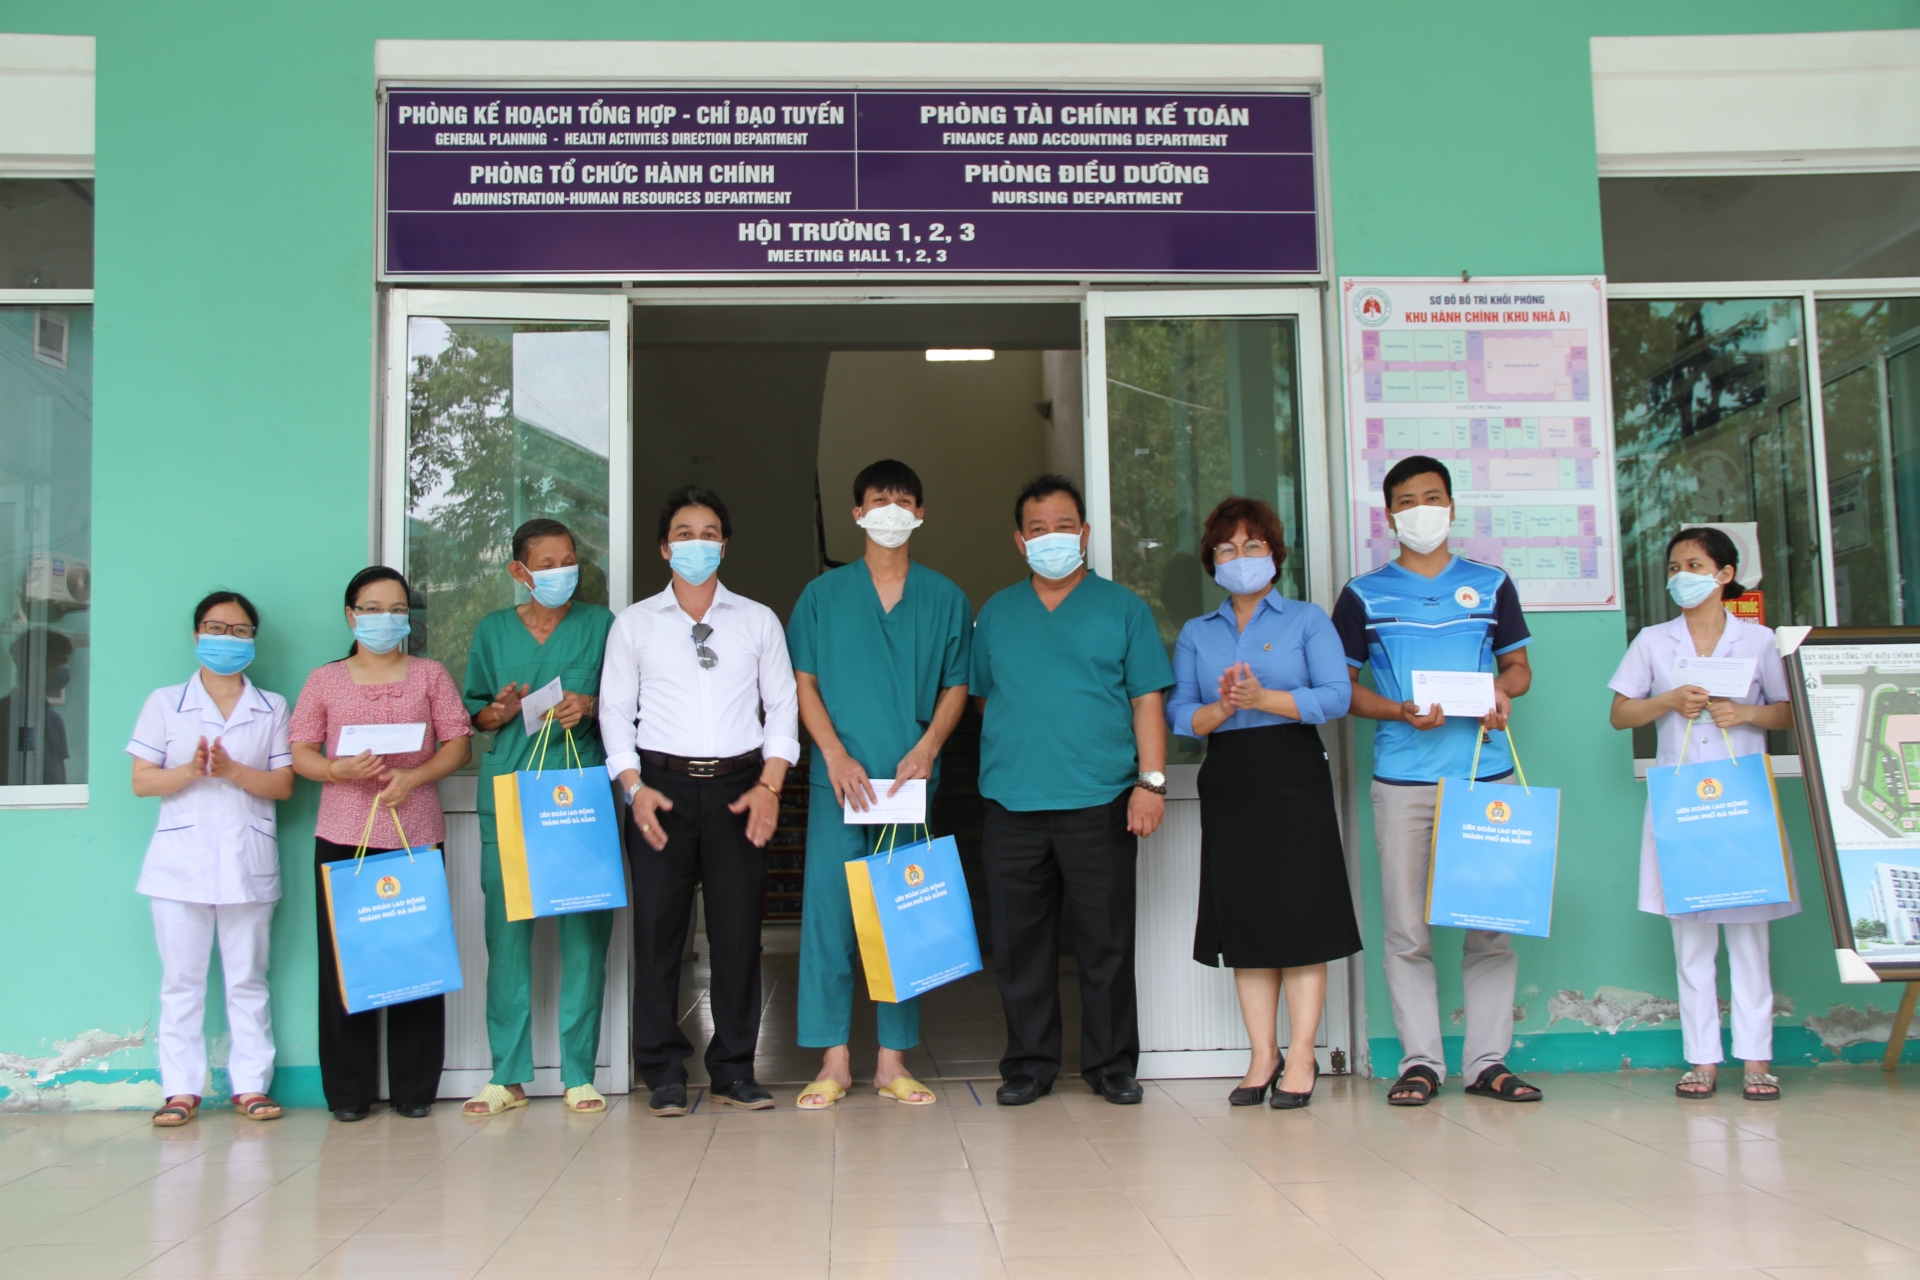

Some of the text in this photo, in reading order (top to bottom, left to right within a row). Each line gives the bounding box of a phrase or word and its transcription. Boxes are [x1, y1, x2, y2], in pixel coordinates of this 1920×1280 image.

[399, 102, 467, 124] PHÒNG
[474, 101, 500, 124] KẾ
[506, 106, 572, 128] HOẠCH
[578, 99, 630, 124] TỔNG
[637, 105, 676, 128] HỢP
[697, 100, 730, 124] CHỈ
[736, 106, 775, 128] ĐẠO
[782, 101, 844, 124] TUYẾN
[921, 102, 1249, 125] PHÒNG TÀI CHÍNH KẾ TOÁN
[436, 133, 486, 145] GENERAL
[490, 133, 547, 145] PLANNING
[565, 133, 605, 145] HEALTH
[609, 133, 668, 145] ACTIVITIES
[672, 133, 731, 145] DIRECTION
[734, 133, 808, 145] DEPARTMENT
[943, 133, 1228, 146] FINANCE AND ACCOUNTING DEPARTMENT
[471, 158, 774, 184] PHÒNG TỔ CHỨC HÀNH CHÍNH
[965, 160, 1208, 183] PHÒNG ĐIỀU DƯỠNG
[453, 192, 792, 205] ADMINISTRATION-HUMAN RESOURCES DEPARTMENT
[992, 191, 1183, 204] NURSING DEPARTMENT
[739, 219, 975, 245] HỘI TRƯỜNG 1, 2, 3
[768, 250, 947, 263] MEETING HALL 1, 2, 3
[1429, 293, 1545, 305] SƠ ĐỒ BỐ TRÍ KHỐI PHÒNG
[1405, 309, 1571, 324] KHU HÀNH CHÍNH (KHU NHÀ A)
[1738, 597, 1759, 613] THUỐC
[578, 808, 595, 816] ĐỘNG
[1676, 806, 1690, 814] LIÊN
[1691, 804, 1711, 813] ĐOÀN
[1726, 800, 1748, 808] ĐỘNG
[541, 818, 560, 826] THÀNH
[581, 815, 596, 823] NẴNG
[1677, 814, 1700, 822] THÀNH
[1728, 808, 1749, 817] NẴNG
[1462, 823, 1476, 831] LIÊN
[1477, 825, 1496, 833] ĐOÀN
[1511, 828, 1532, 837] ĐỘNG
[1462, 831, 1532, 845] THÀNH PHỐ ĐÀ NẴNG
[894, 881, 946, 903] LIÊN ĐOÀN LAO ĐỘNG
[358, 906, 372, 915] LIÊN
[372, 903, 392, 912] ĐOÀN
[406, 896, 426, 905] ĐỘNG
[897, 889, 948, 911] THÀNH PHỐ ĐÀ NẴNG
[359, 913, 382, 923] THÀNH
[382, 910, 396, 918] PHỐ
[408, 904, 427, 913] NẴNG
